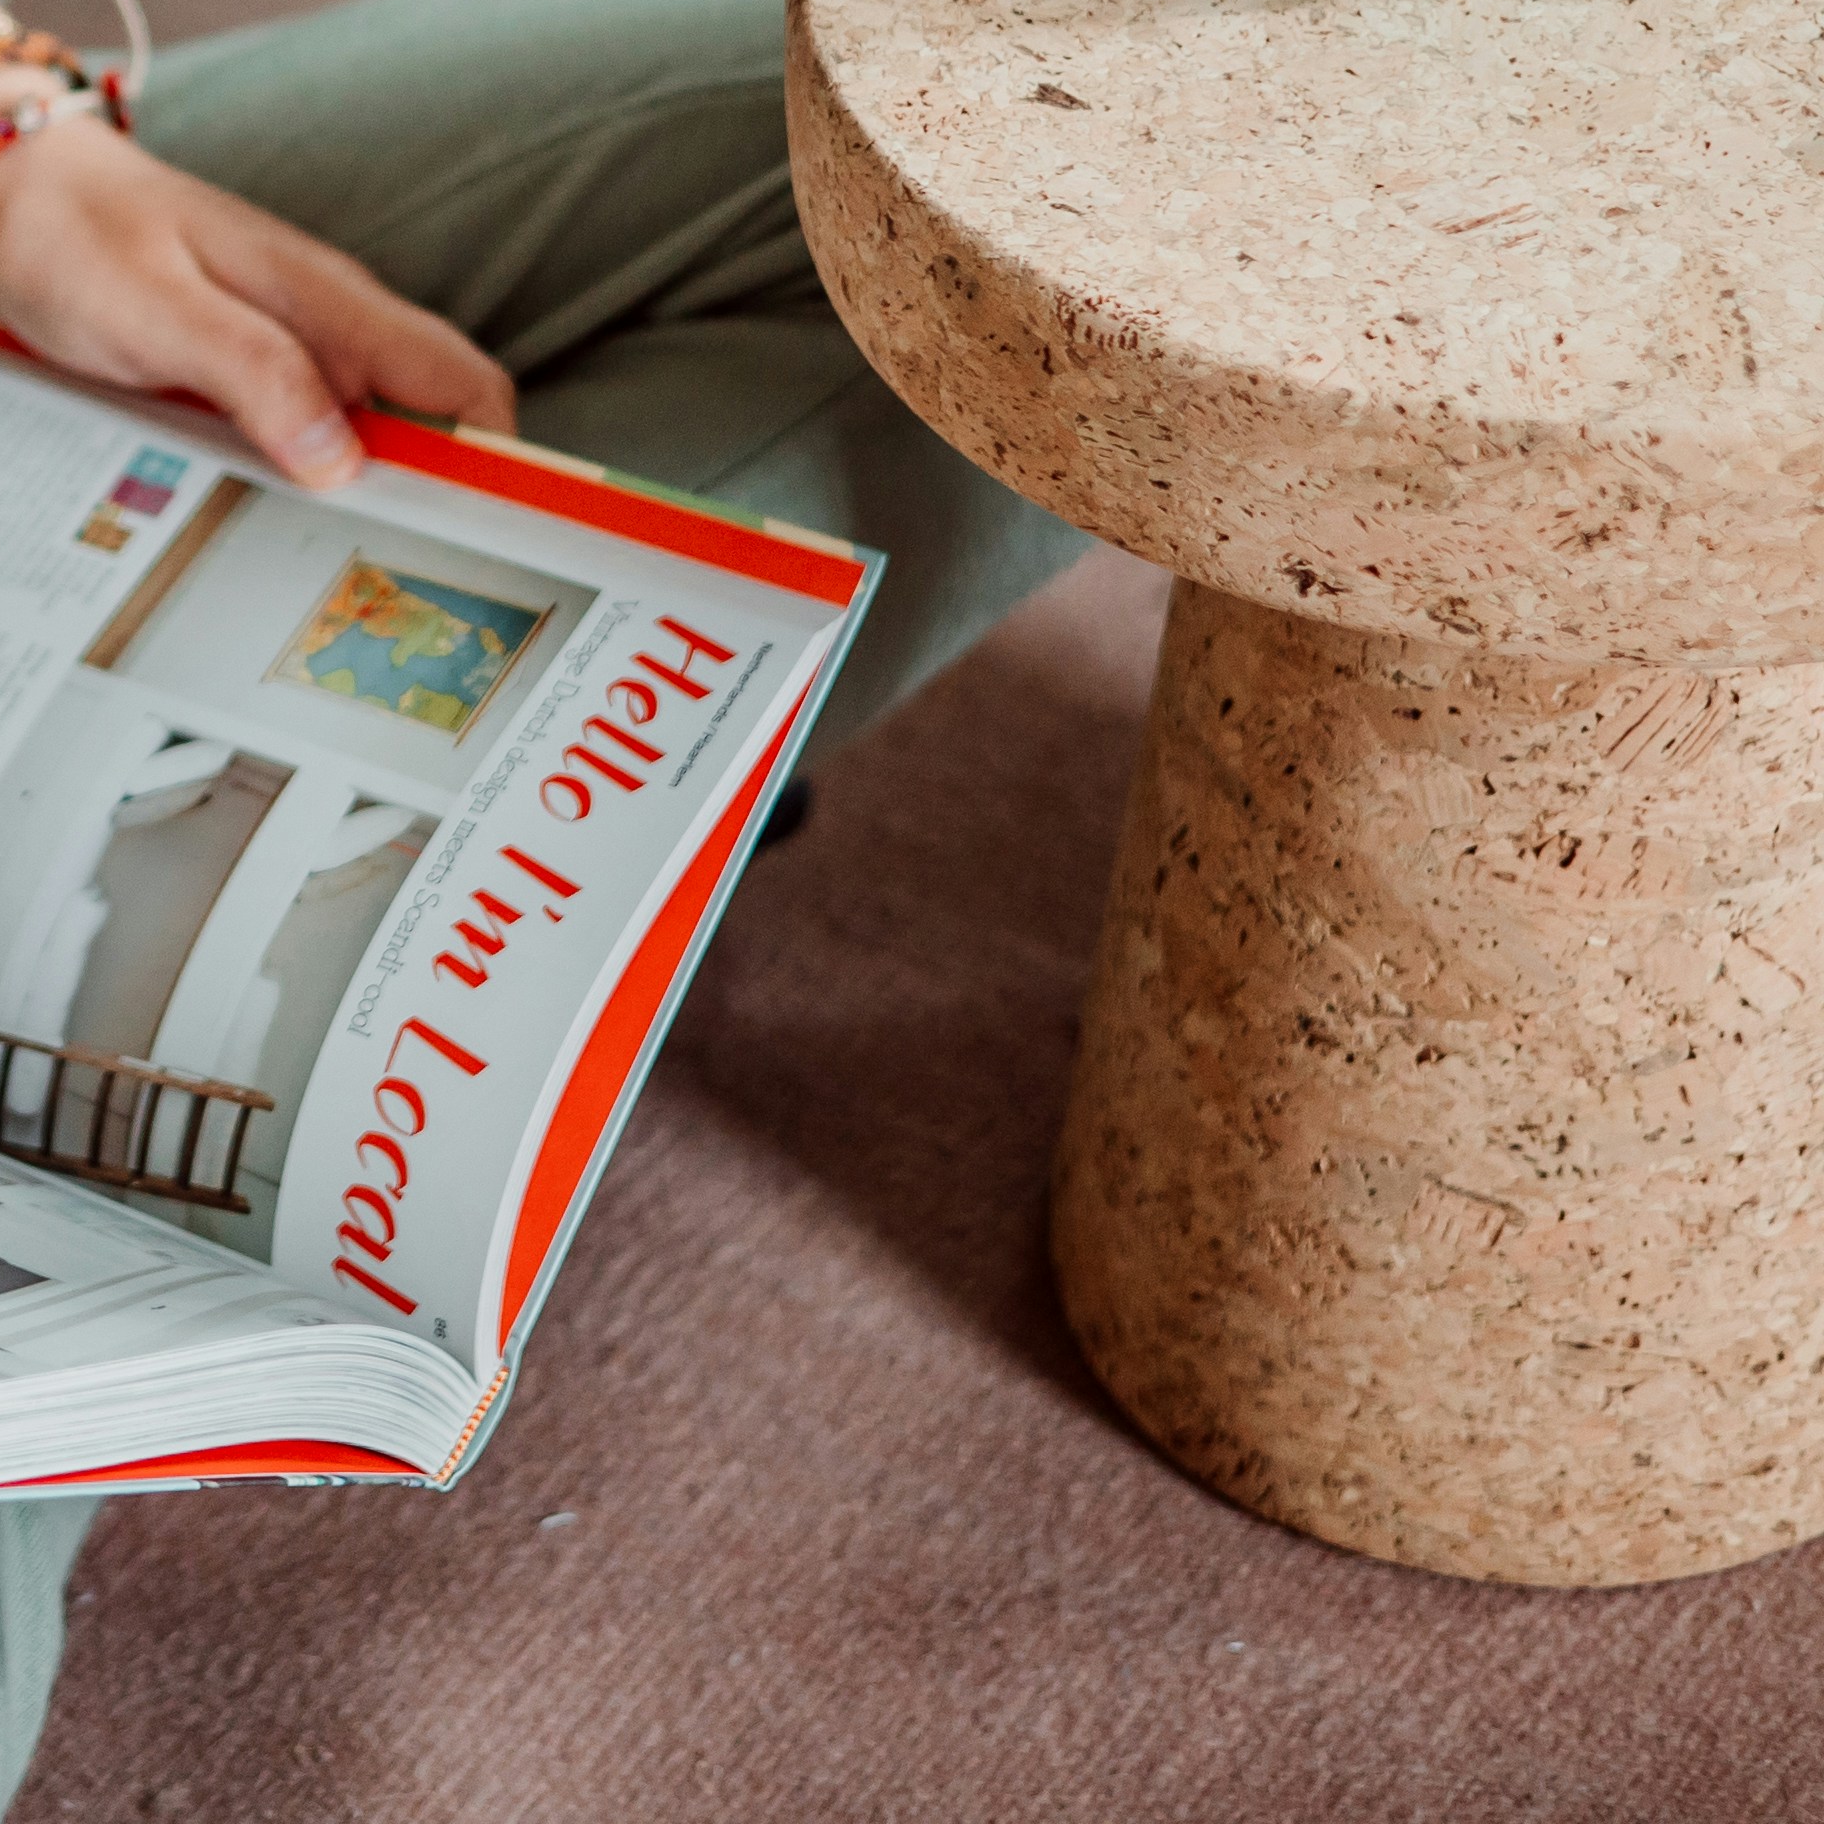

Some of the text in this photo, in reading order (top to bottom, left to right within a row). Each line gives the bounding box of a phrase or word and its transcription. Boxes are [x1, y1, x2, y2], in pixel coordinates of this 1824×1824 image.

[670, 731, 713, 787] Haarlem
[711, 641, 774, 723] Netherlands
[347, 599, 640, 1038] Vintage Dutch design meets Scandi-cool
[331, 615, 738, 1316] Hello I'm Local
